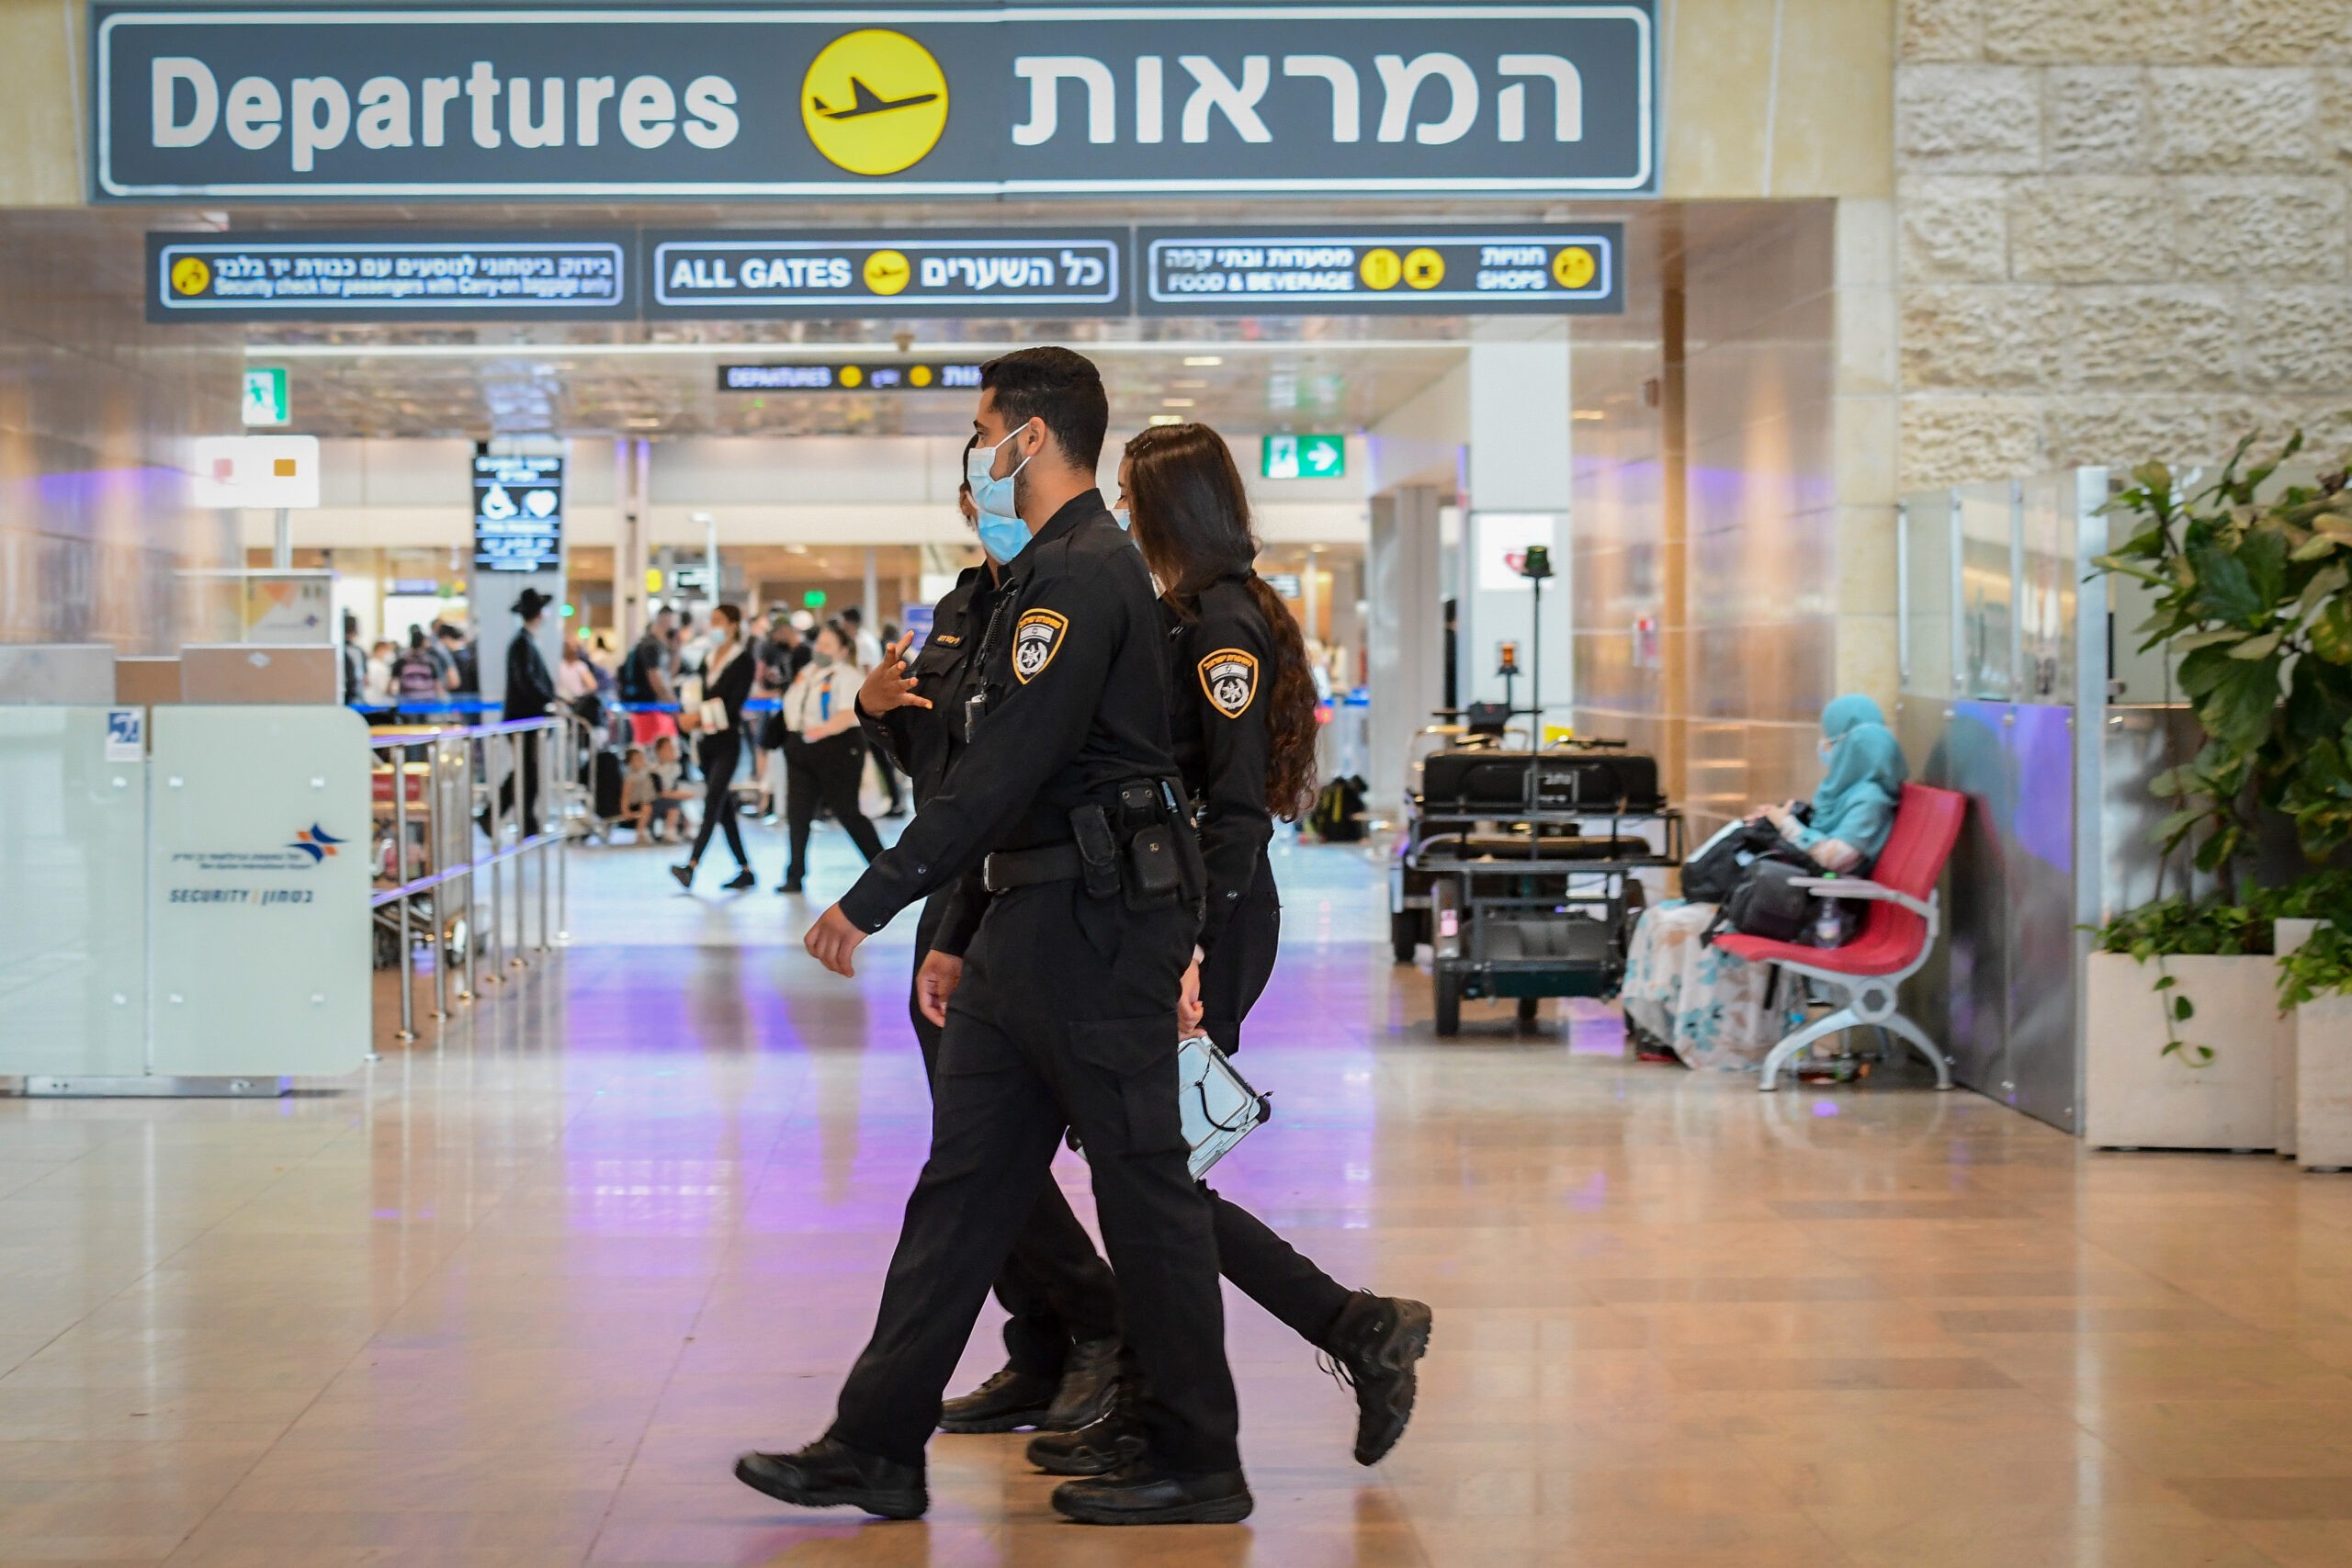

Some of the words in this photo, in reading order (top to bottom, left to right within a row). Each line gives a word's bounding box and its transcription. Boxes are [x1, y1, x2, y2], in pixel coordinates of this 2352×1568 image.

[1012, 52, 1585, 147] המראות
[151, 56, 741, 173] Departures
[213, 254, 266, 276] בלבד
[268, 258, 291, 276] יד
[359, 257, 392, 277] עם
[1265, 247, 1355, 267] מסעדות
[1480, 246, 1547, 267] חנויות
[669, 259, 736, 289] ALL
[739, 258, 854, 289] GATES
[920, 257, 1055, 290] השערים
[1059, 250, 1104, 287] כל
[1168, 272, 1225, 292] FOOD
[1227, 272, 1246, 292] &
[1248, 271, 1355, 292] BEVERAGE
[1476, 270, 1547, 290] SHOPS
[170, 889, 249, 904] SECURITY
[261, 890, 314, 906] בטחון
